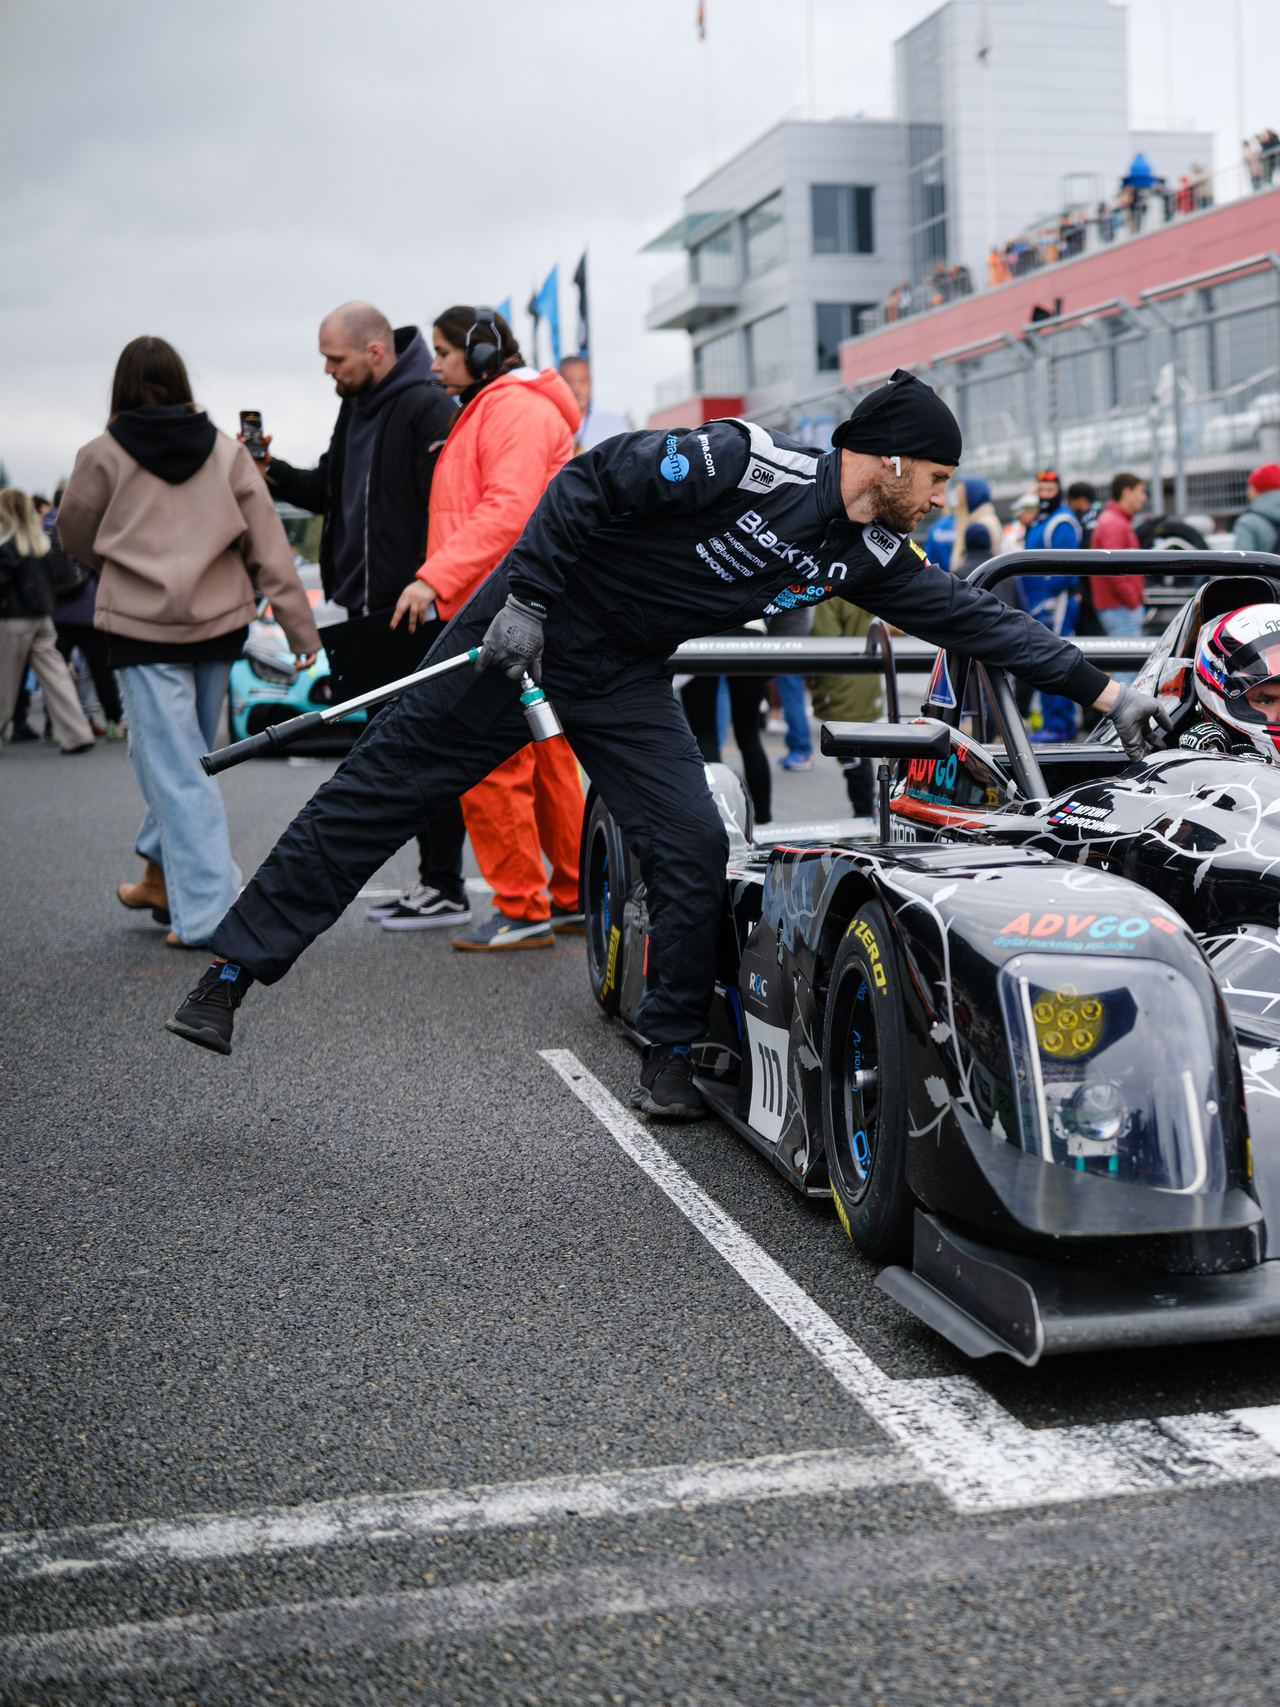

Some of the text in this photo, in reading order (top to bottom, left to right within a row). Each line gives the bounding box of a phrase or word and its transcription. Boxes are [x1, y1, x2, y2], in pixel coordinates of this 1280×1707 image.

[667, 434, 684, 483] terasms
[698, 434, 716, 478] me.com
[752, 468, 775, 485] OMP
[870, 529, 895, 551] OMP
[696, 542, 737, 584] SHONX
[846, 919, 858, 938] P
[854, 920, 887, 987] ZERO
[992, 936, 1136, 951] digital marketing solutions
[758, 1041, 783, 1117] 111
